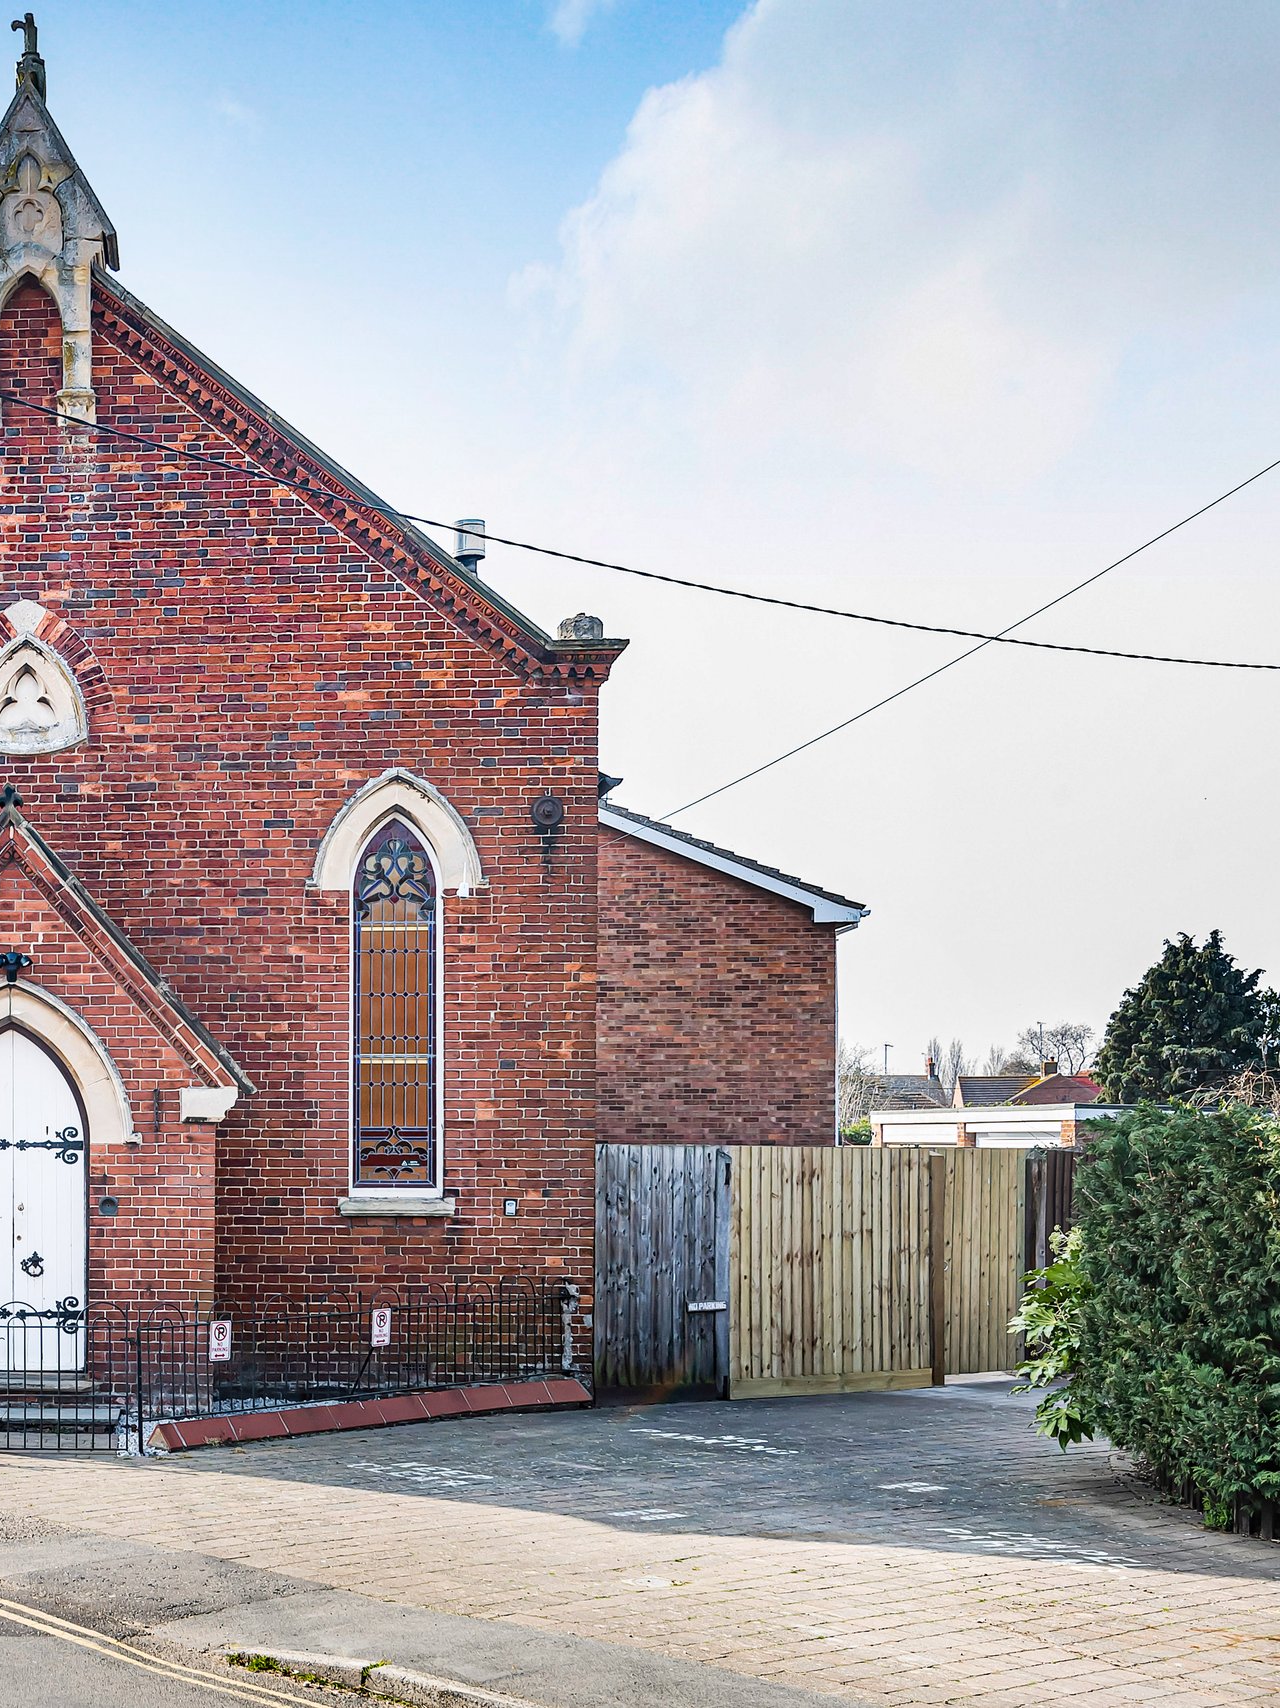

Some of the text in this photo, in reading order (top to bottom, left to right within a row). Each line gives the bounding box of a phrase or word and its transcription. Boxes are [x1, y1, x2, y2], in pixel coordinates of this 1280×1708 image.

[688, 1301, 727, 1311] NO PARKING
[391, 1461, 494, 1480] KEEP
